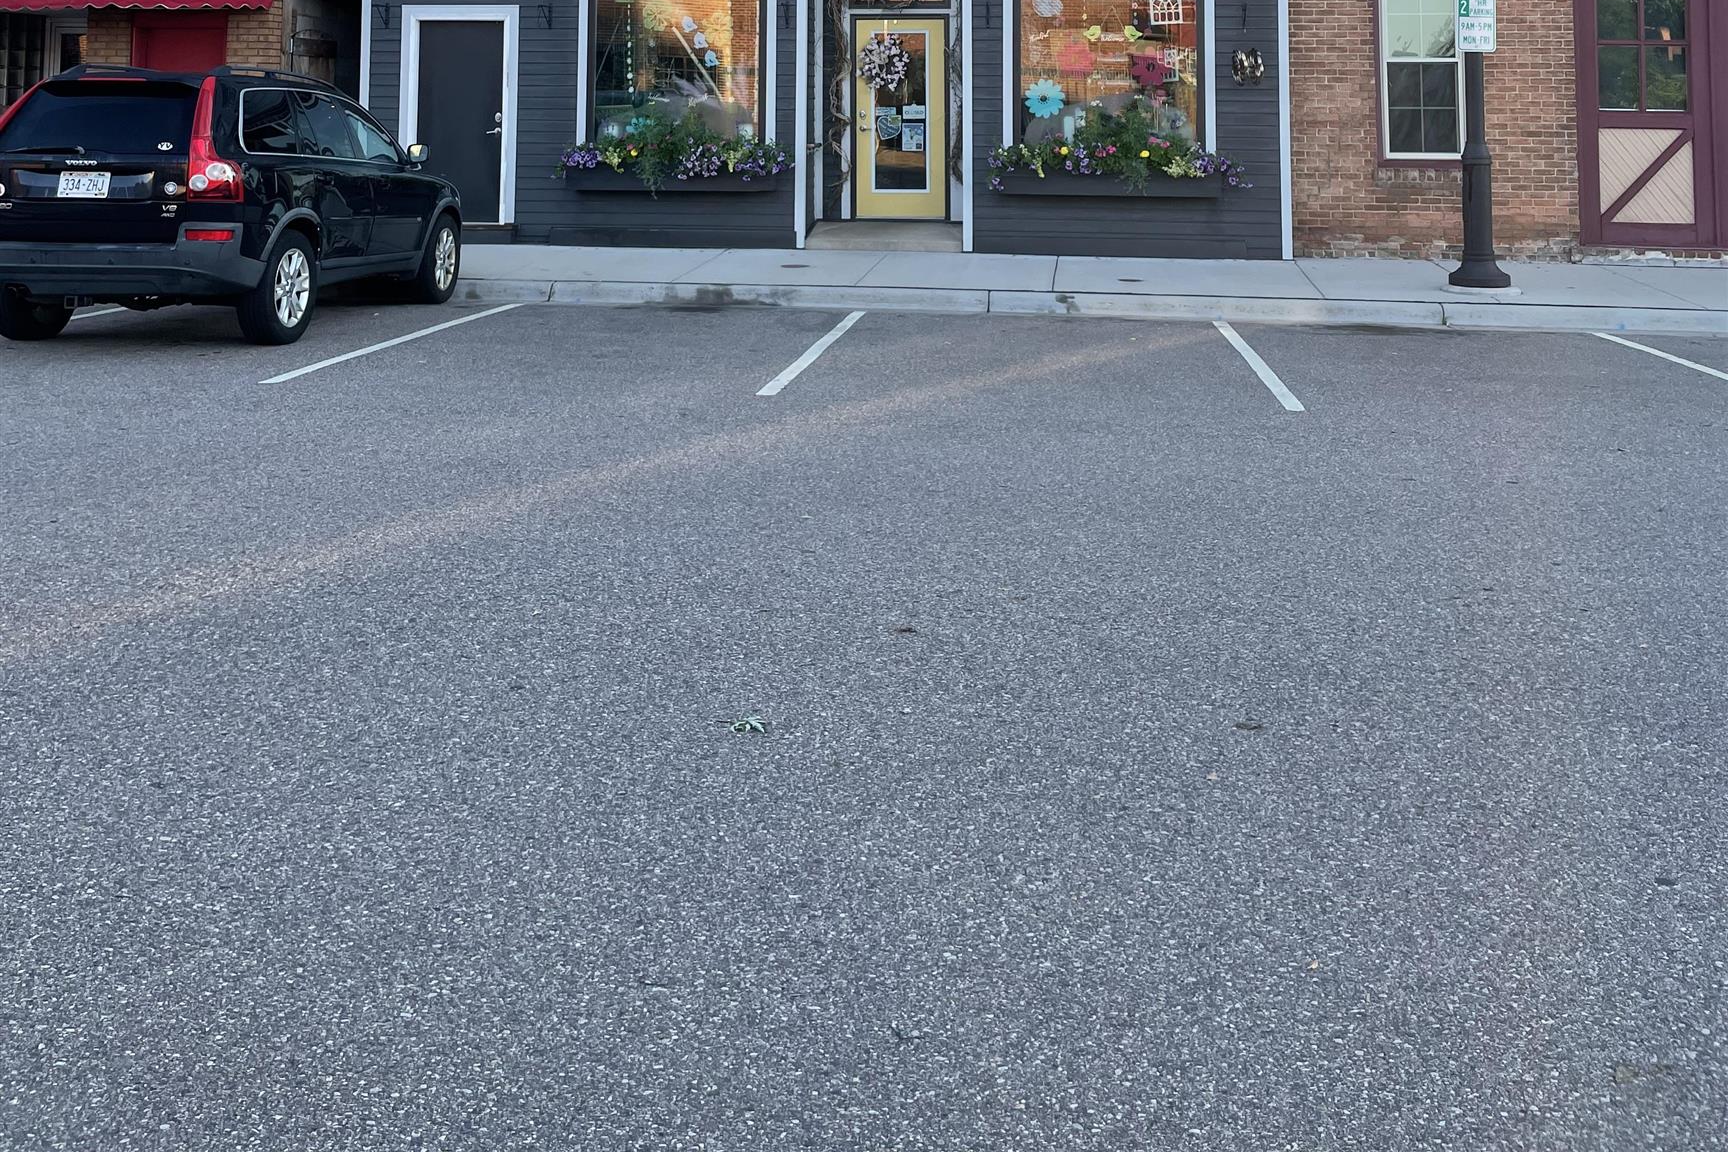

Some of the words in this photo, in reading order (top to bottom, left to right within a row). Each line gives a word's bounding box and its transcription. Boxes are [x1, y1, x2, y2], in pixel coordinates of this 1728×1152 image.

[1460, 0, 1467, 14] 2
[1470, 8, 1493, 16] PARKING
[63, 178, 105, 192] 334-ZHJ
